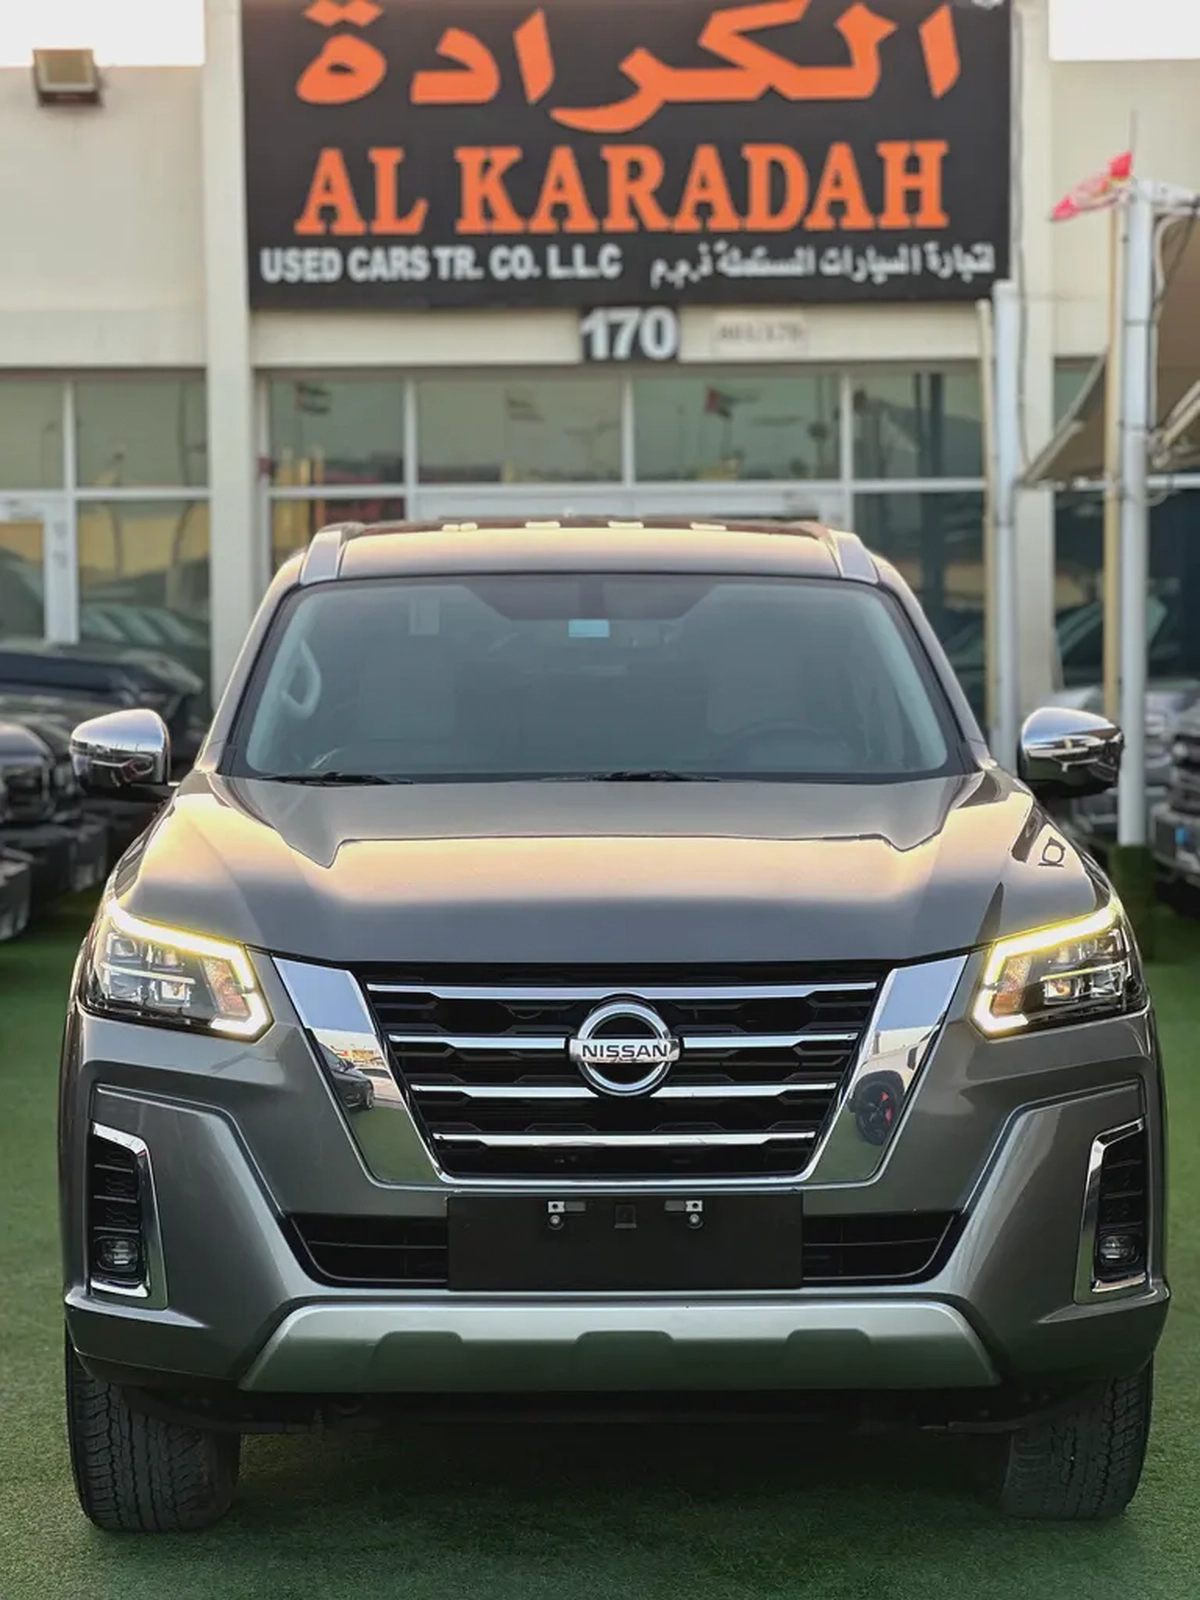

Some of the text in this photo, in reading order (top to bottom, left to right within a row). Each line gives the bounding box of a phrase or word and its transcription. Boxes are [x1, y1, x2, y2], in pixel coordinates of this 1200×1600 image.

[296, 0, 960, 133] الكرادة
[294, 140, 949, 235] AL KARADAH
[260, 247, 341, 283] USED
[347, 246, 430, 281] CARS
[433, 246, 483, 280] TR.
[490, 246, 541, 279] CO.
[580, 306, 679, 361] 170
[582, 1045, 668, 1058] NISSAN
